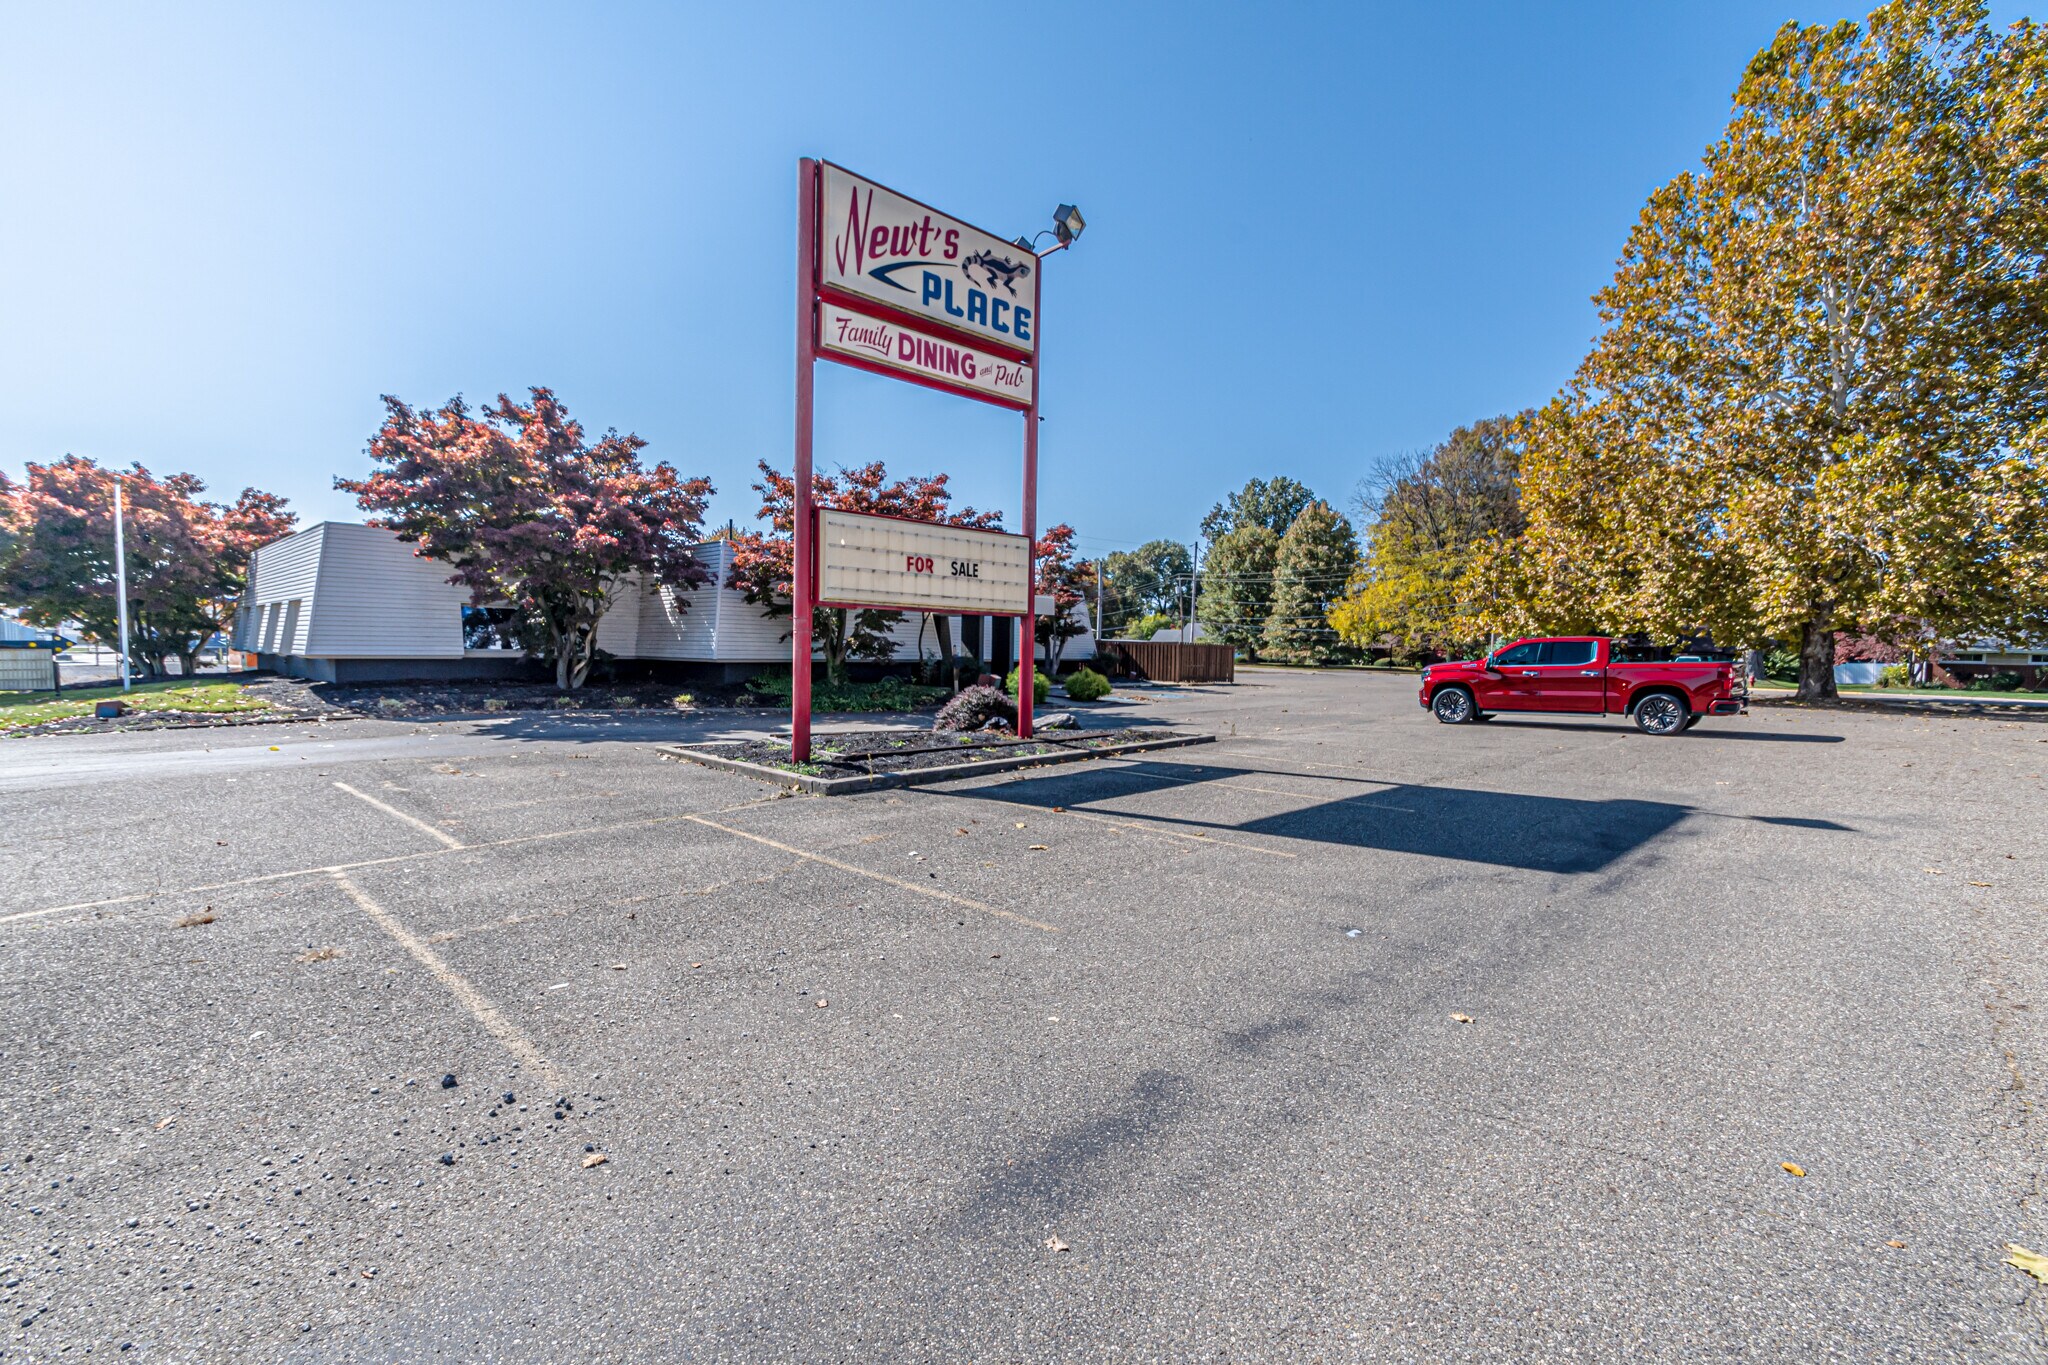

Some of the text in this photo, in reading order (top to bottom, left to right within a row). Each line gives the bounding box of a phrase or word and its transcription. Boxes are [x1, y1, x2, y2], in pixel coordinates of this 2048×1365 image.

[836, 186, 960, 277] Newt's
[922, 270, 1032, 341] PLACE
[836, 316, 1024, 387] Family DINING and Pub
[906, 556, 979, 578] FOR SALE
